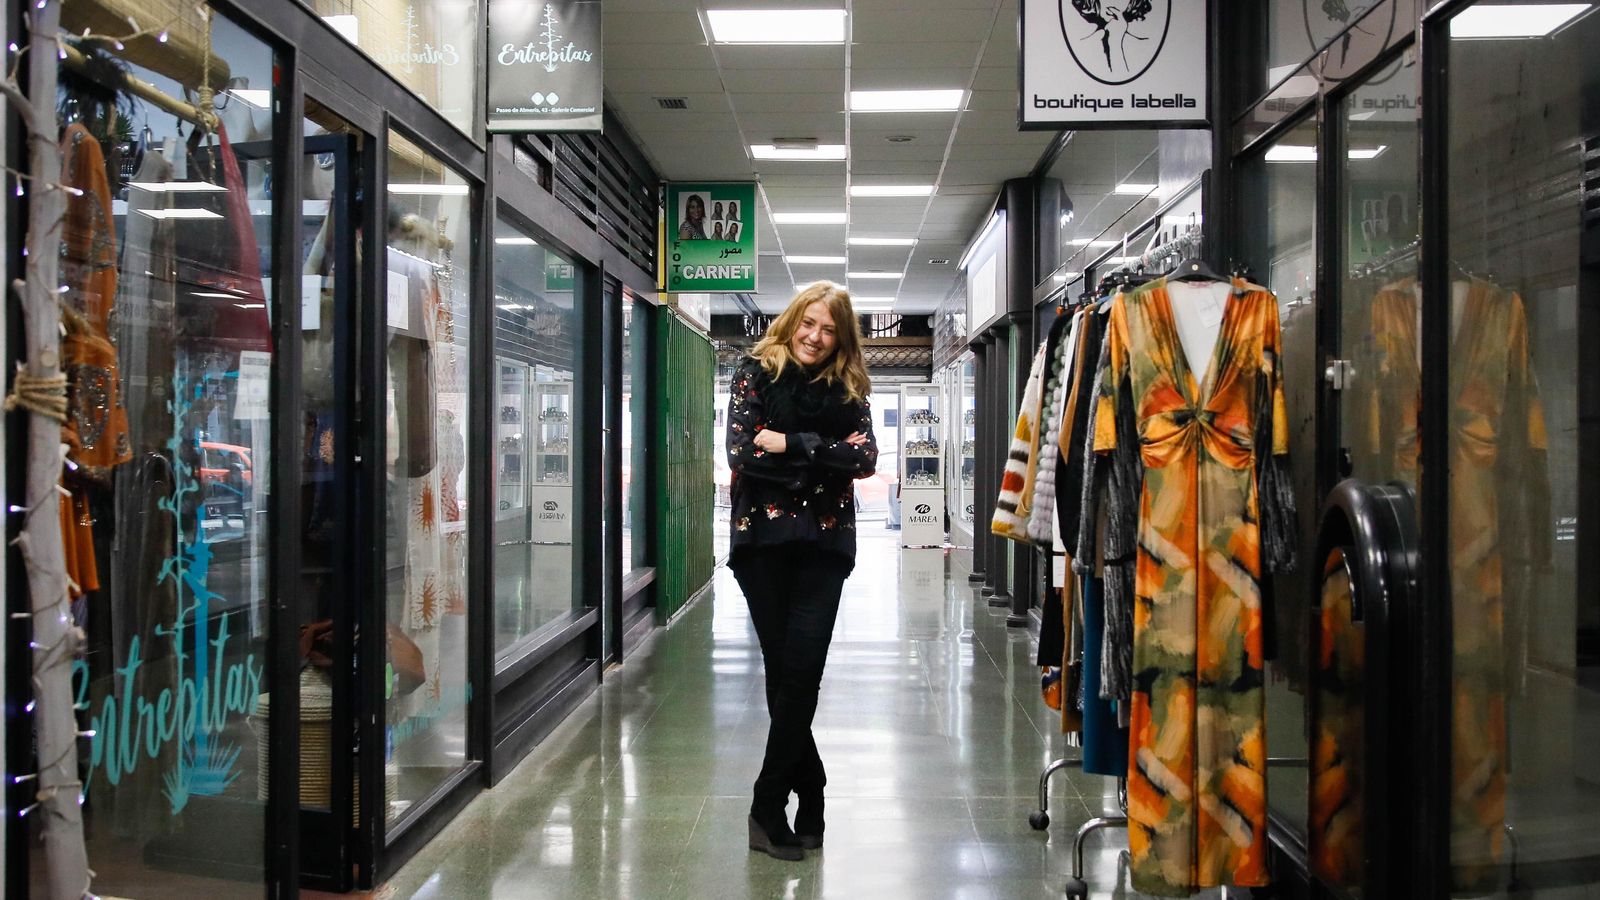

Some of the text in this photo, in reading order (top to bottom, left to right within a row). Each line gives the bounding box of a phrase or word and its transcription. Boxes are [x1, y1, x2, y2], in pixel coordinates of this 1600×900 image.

[498, 42, 593, 66] Entrepitas
[1034, 94, 1197, 113] boutique labella
[672, 242, 681, 285] FOTO
[682, 265, 752, 280] CARNET
